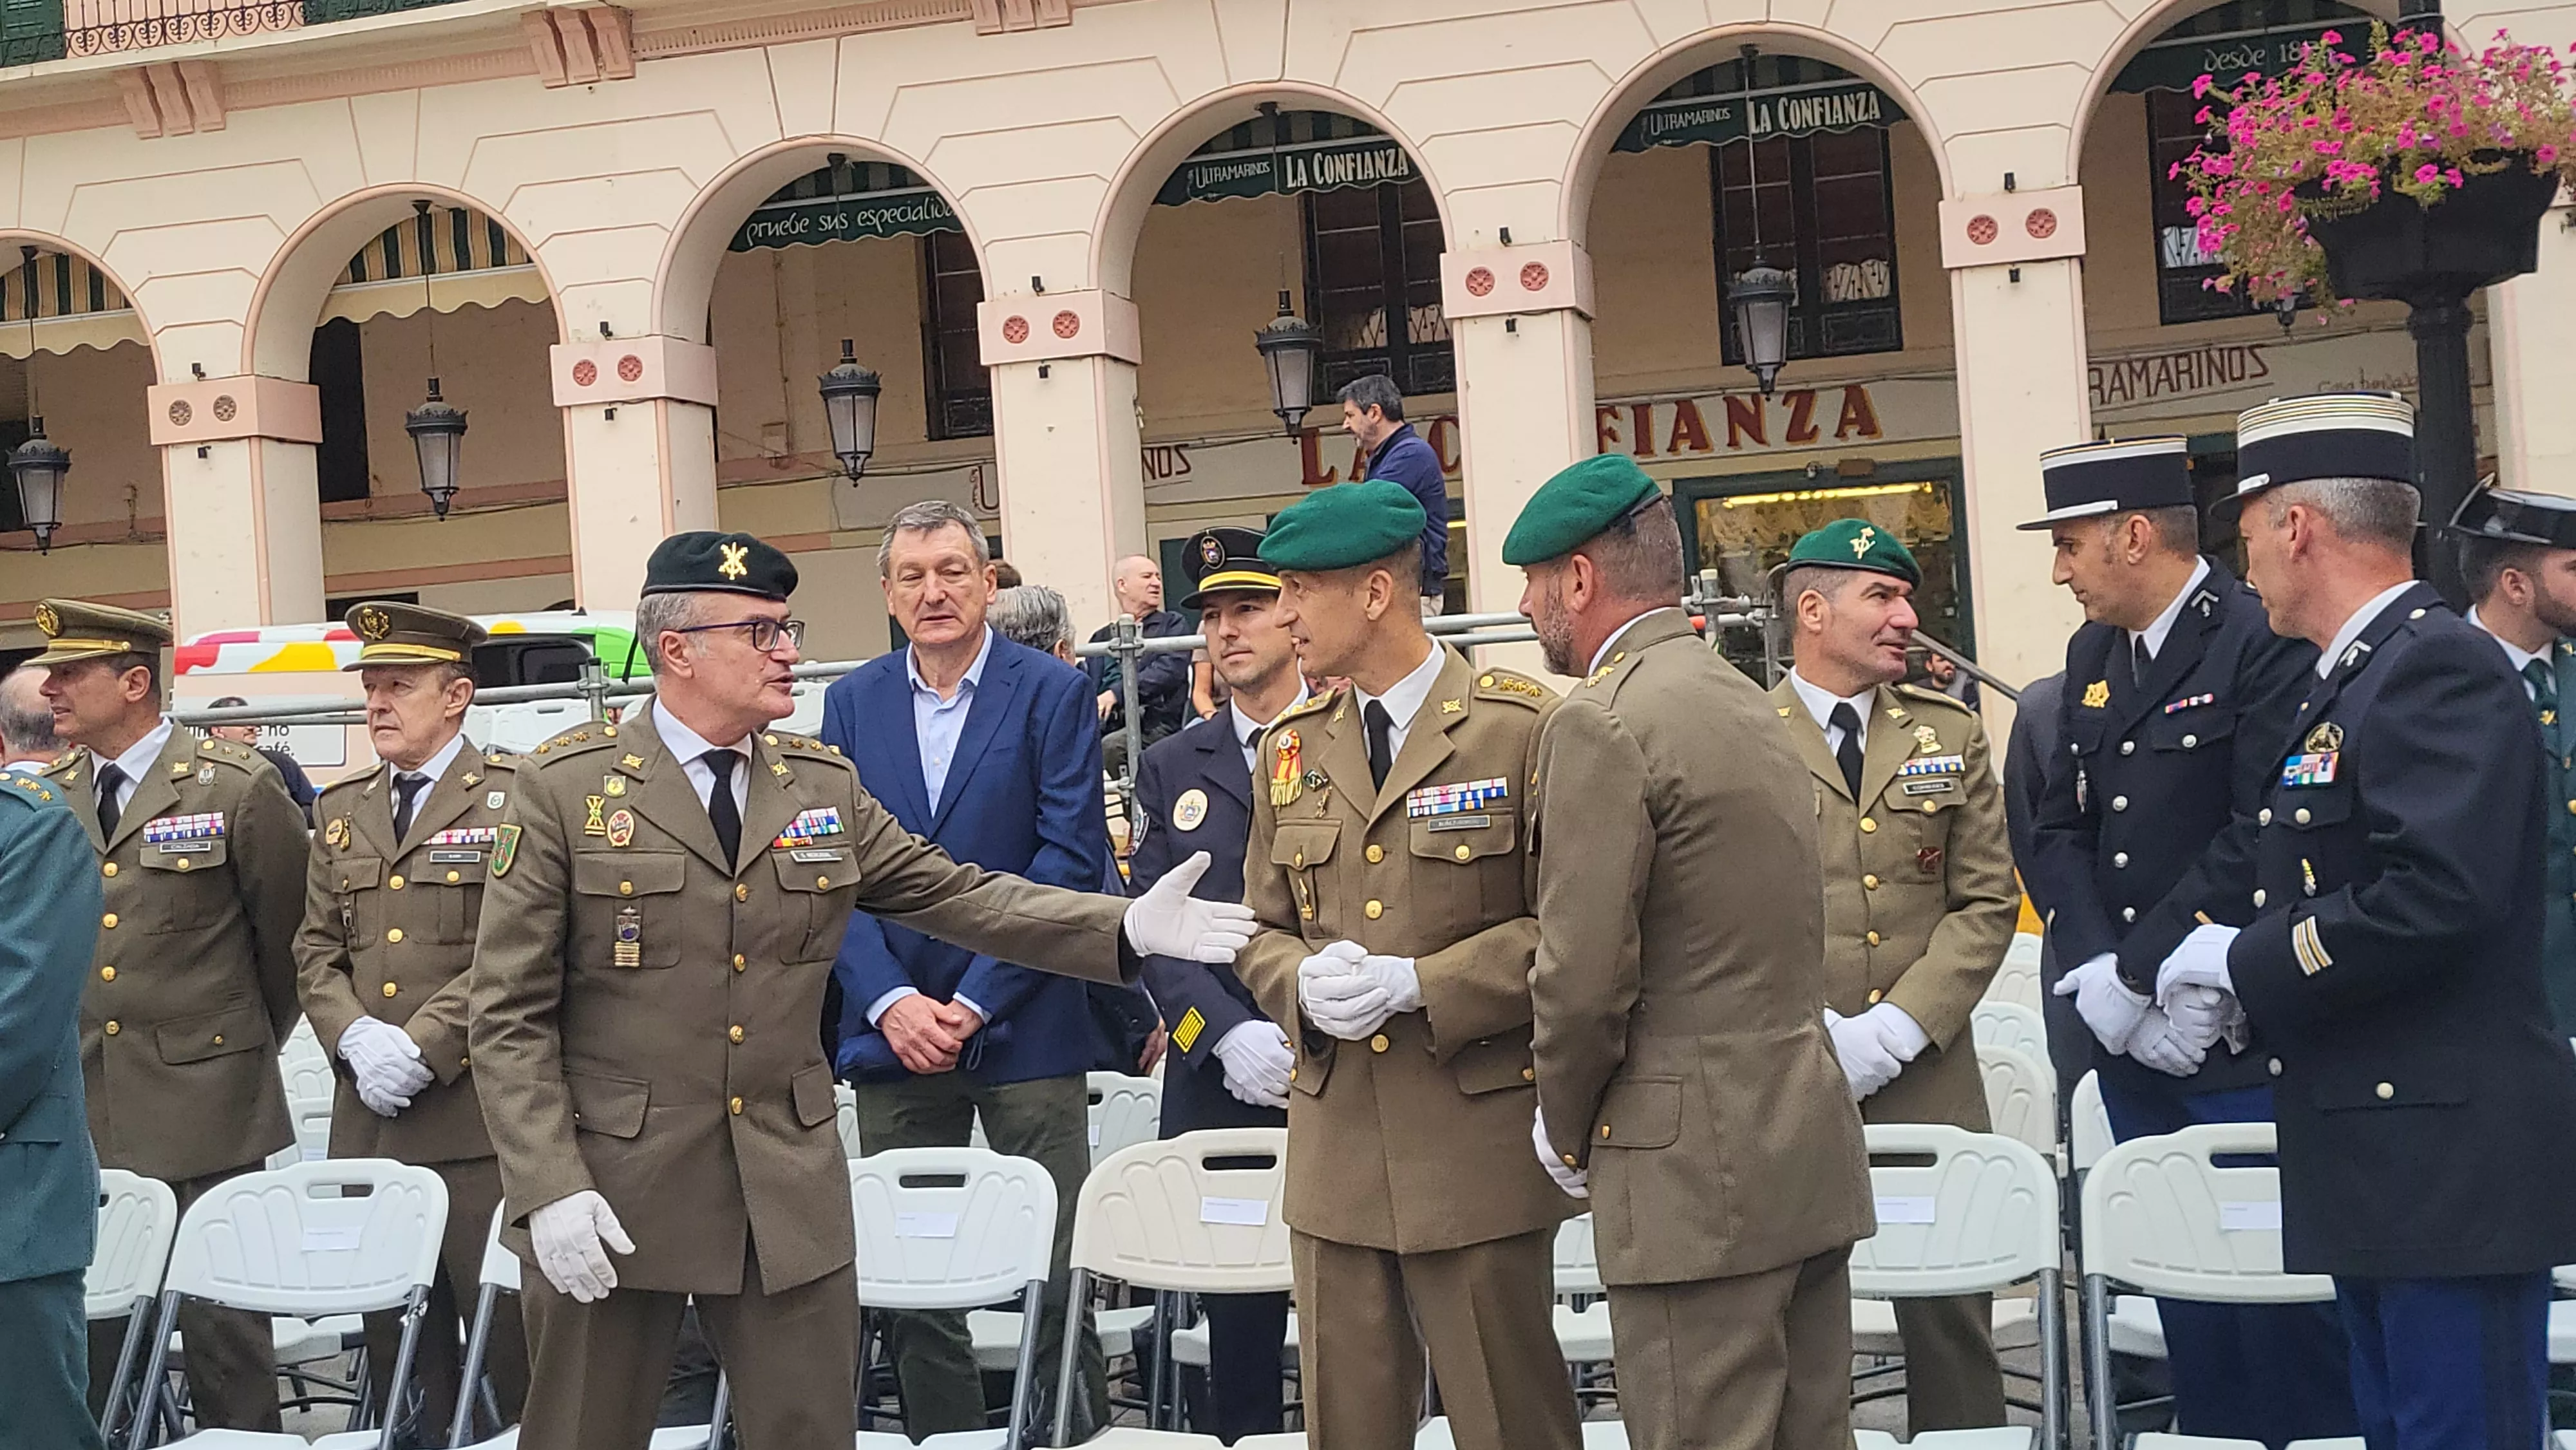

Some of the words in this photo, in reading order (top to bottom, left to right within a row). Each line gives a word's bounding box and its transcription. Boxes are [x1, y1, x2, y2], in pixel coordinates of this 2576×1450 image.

[2204, 44, 2266, 71] desde
[1777, 90, 1881, 131] CONFIANZA
[1285, 155, 1308, 188] LA
[1312, 147, 1410, 185] CONFIANZA
[746, 212, 810, 247] pruebe
[2088, 344, 2271, 405] RAMARINOS
